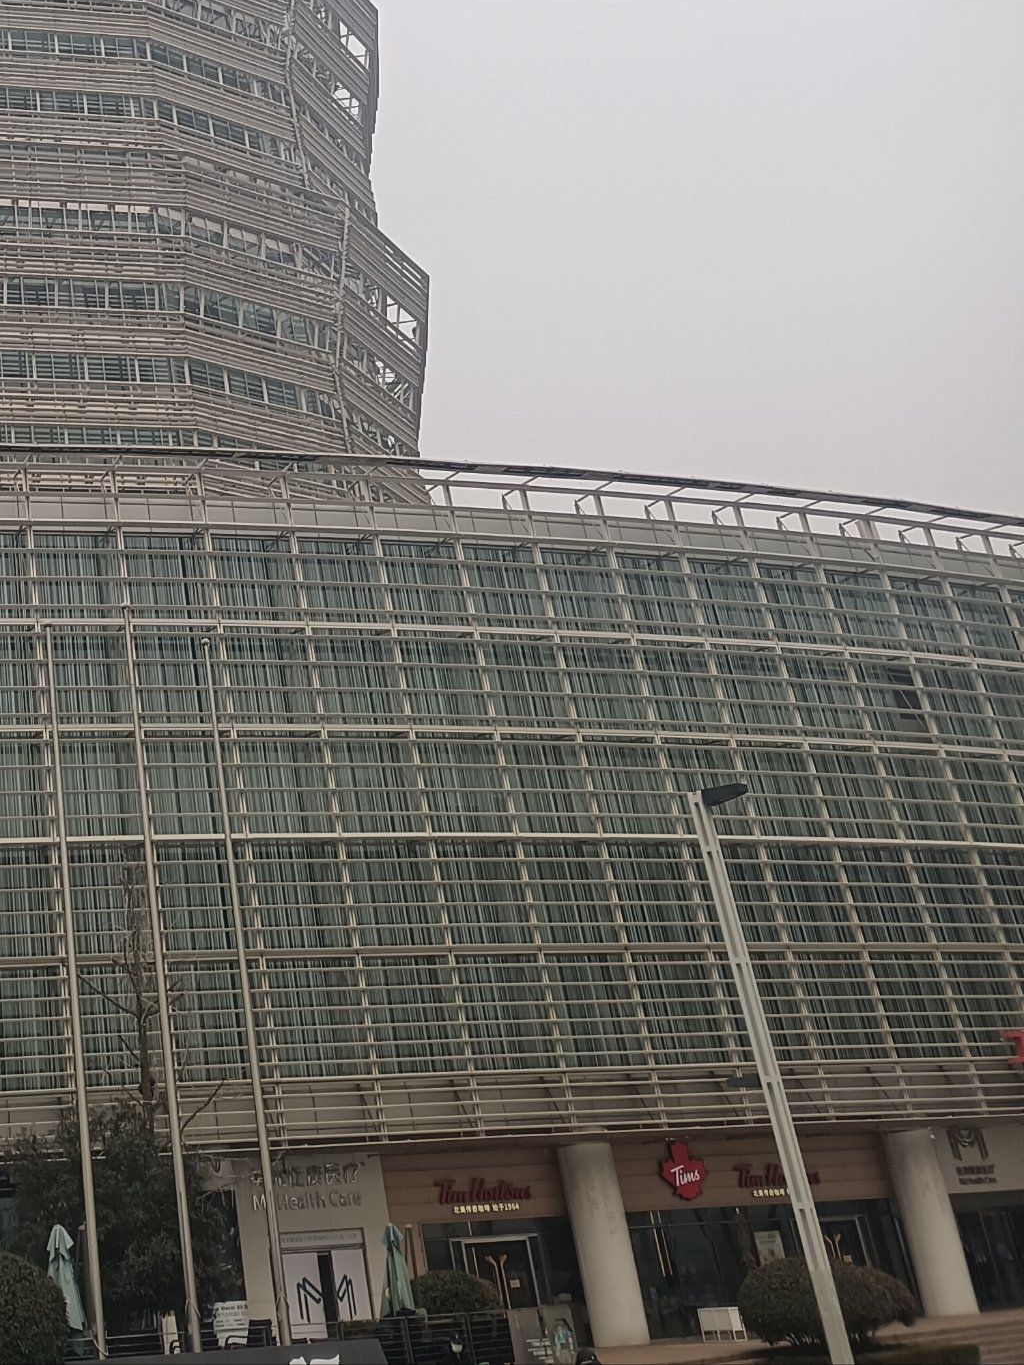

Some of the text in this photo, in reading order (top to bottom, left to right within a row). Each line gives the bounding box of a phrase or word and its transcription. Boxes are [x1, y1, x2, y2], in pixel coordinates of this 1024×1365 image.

[670, 1164, 701, 1187] Tims
[278, 1191, 326, 1211] Health
[329, 1190, 362, 1207] Care
